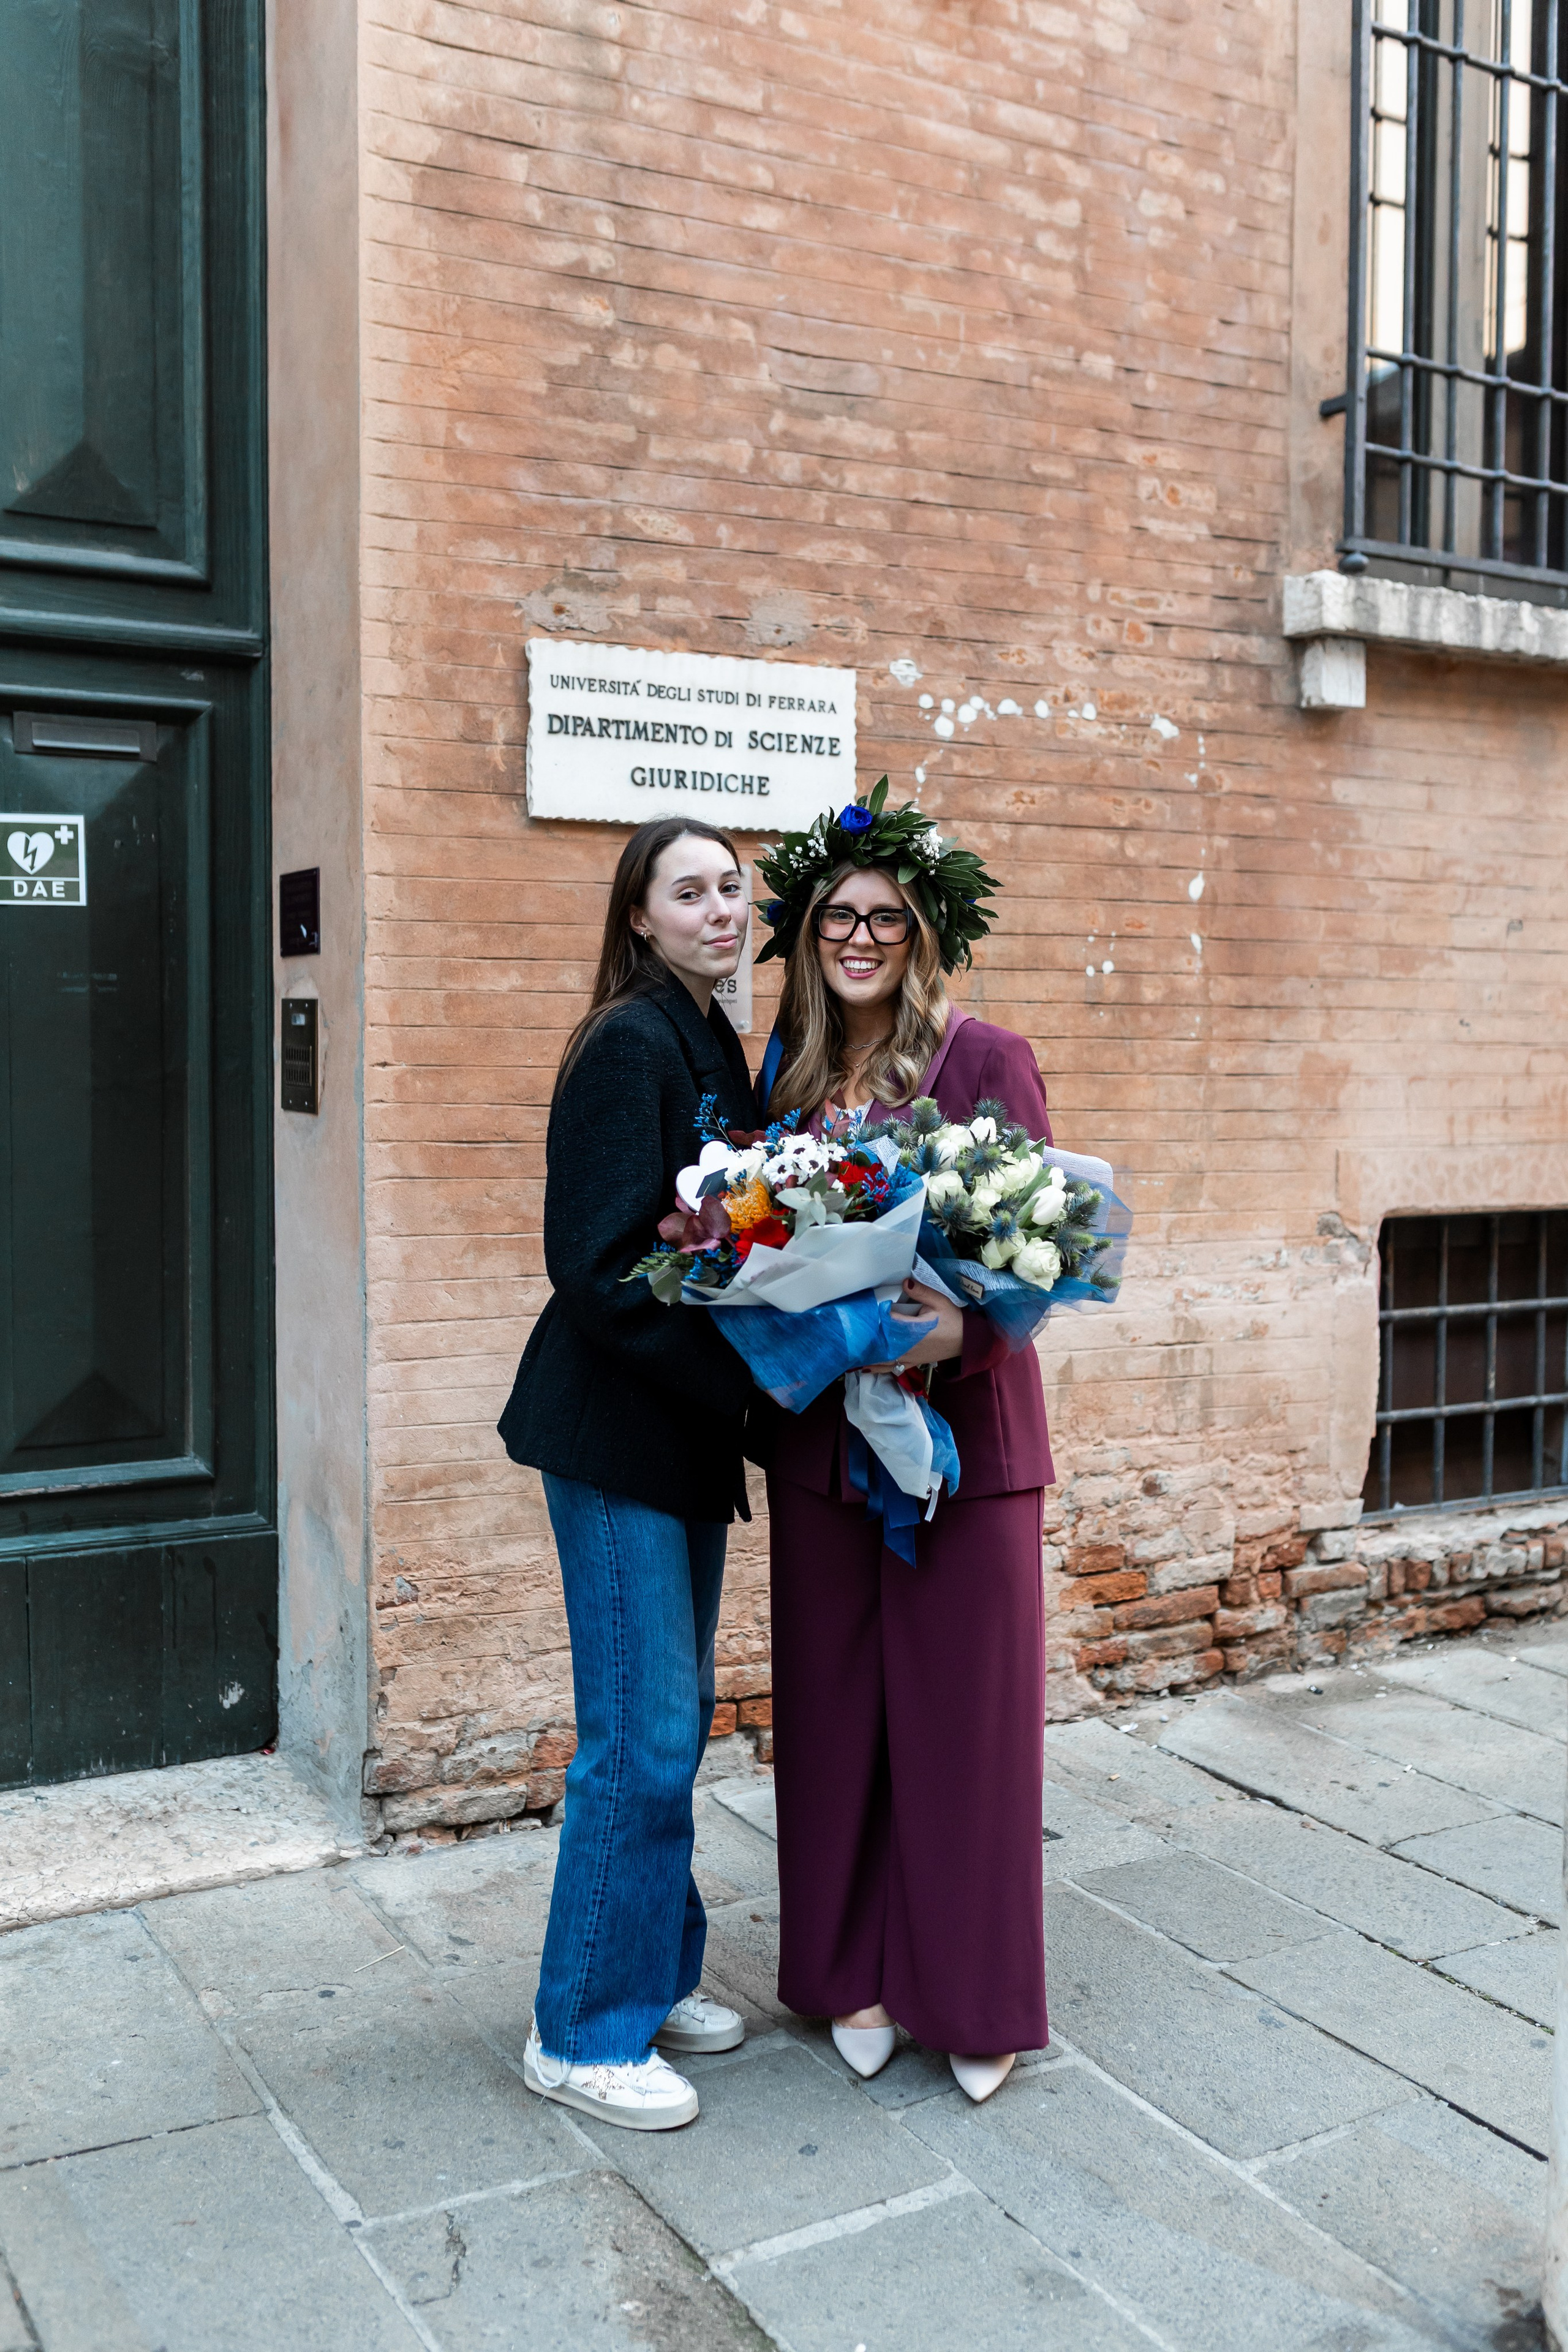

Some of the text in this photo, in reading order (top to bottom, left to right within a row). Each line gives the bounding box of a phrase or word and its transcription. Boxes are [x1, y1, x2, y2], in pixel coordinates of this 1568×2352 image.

[647, 683, 691, 701] DEGLI
[698, 689, 739, 705] STUDI
[746, 693, 761, 707] DI
[769, 695, 837, 714] FERRARA
[548, 713, 841, 756] DIPARTIMENTO DI SCIENZE
[631, 766, 770, 796] GIURIDICHE
[13, 880, 66, 898] DAE
